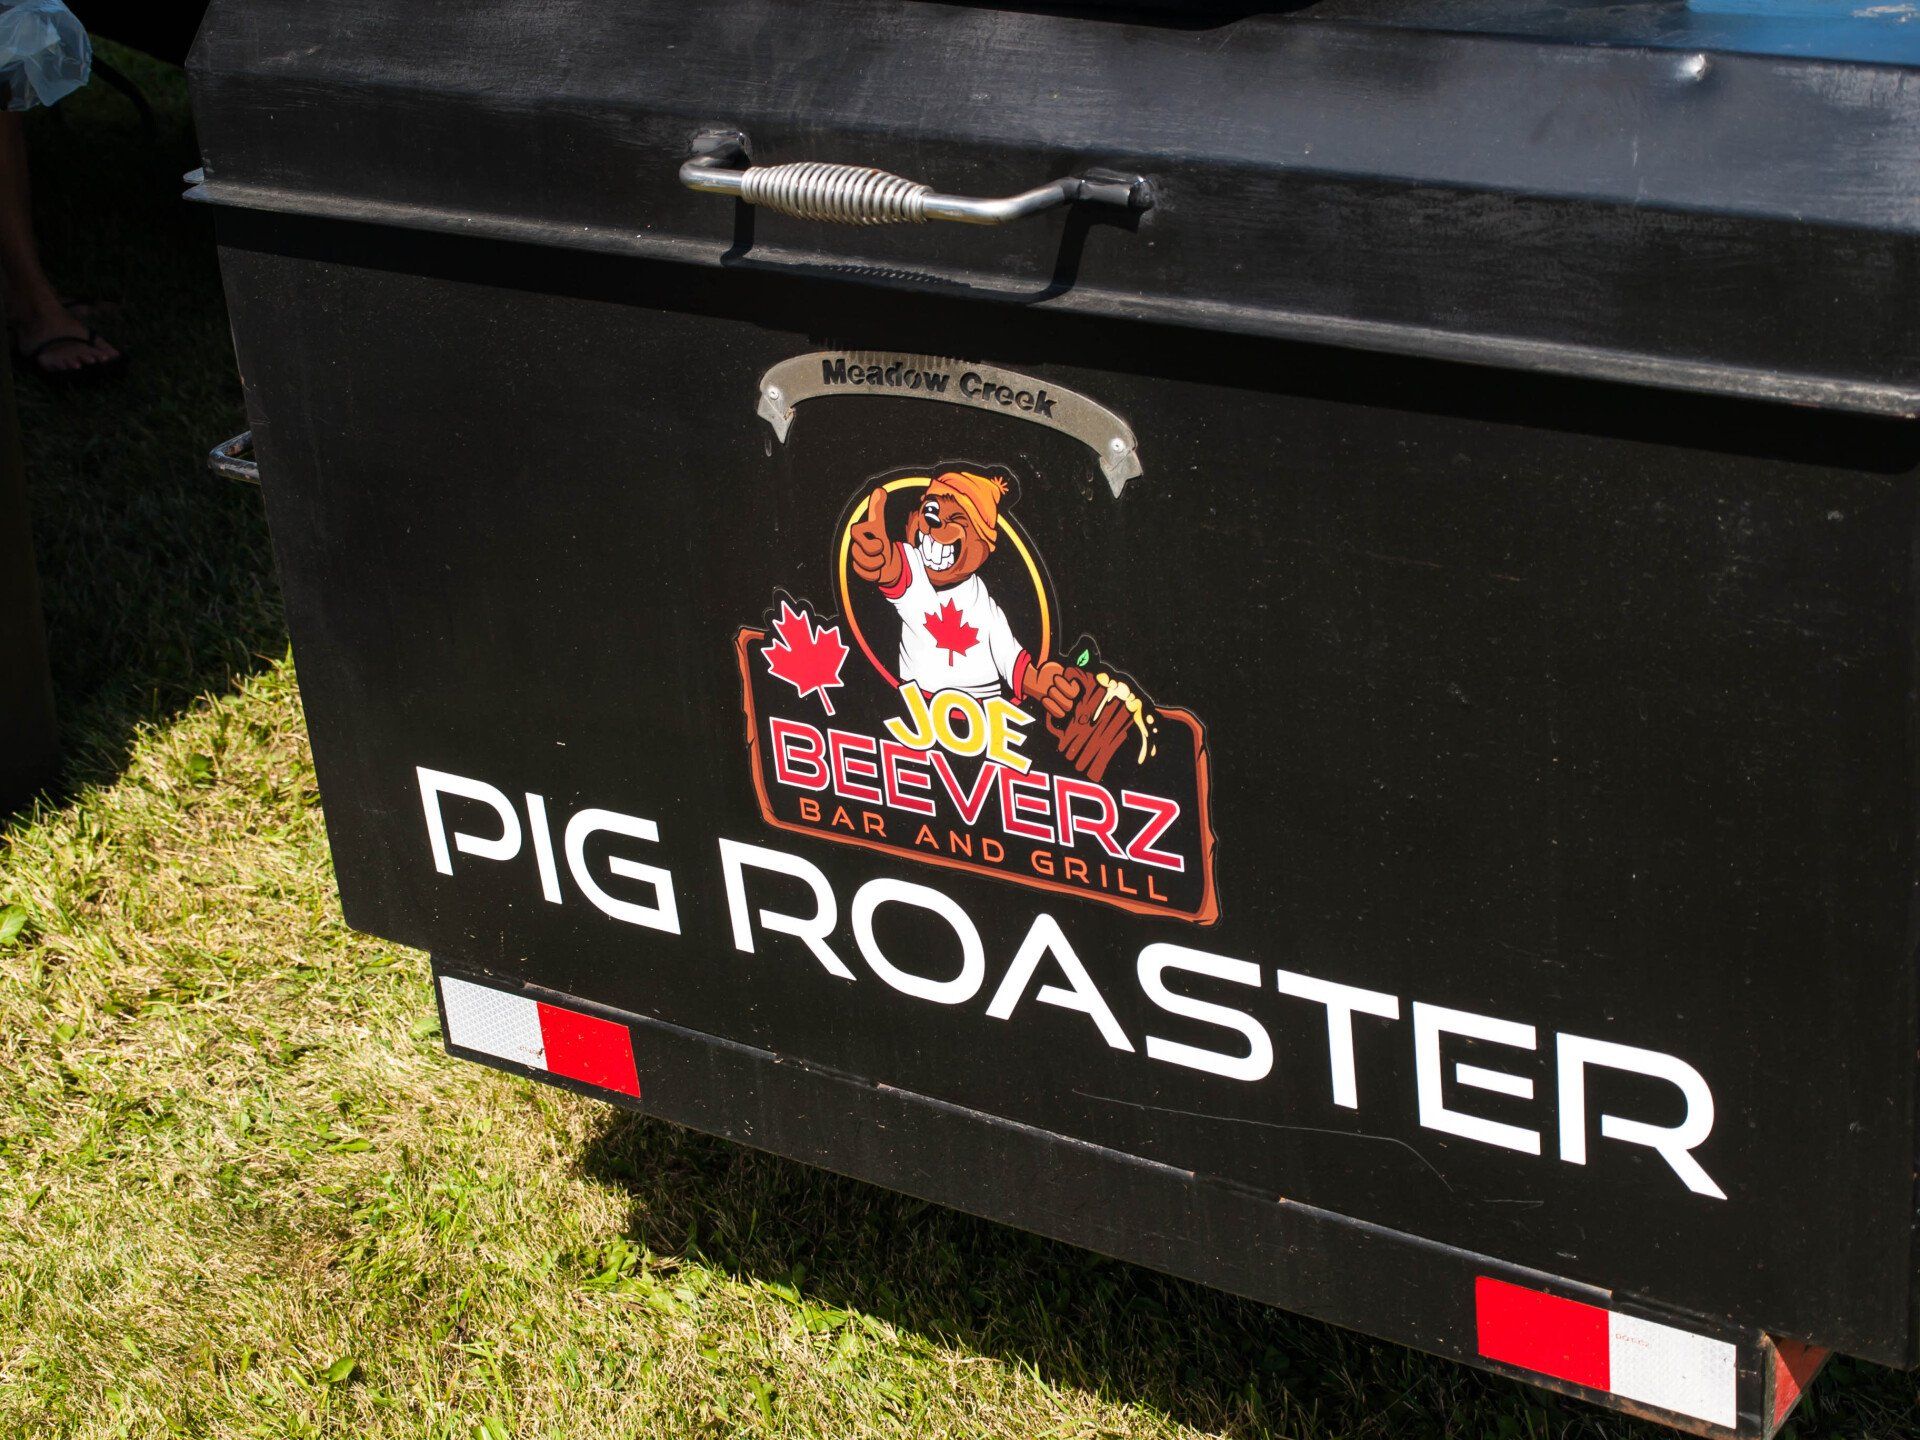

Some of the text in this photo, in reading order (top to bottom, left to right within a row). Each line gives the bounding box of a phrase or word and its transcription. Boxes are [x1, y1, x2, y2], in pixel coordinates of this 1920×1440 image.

[822, 359, 1057, 418] Meadow Creek
[884, 680, 1036, 774] JOE
[769, 716, 1185, 873] BEEVERZ
[799, 797, 1169, 902] BAR AND GRILL
[416, 766, 1727, 1200] PIG ROASTER
